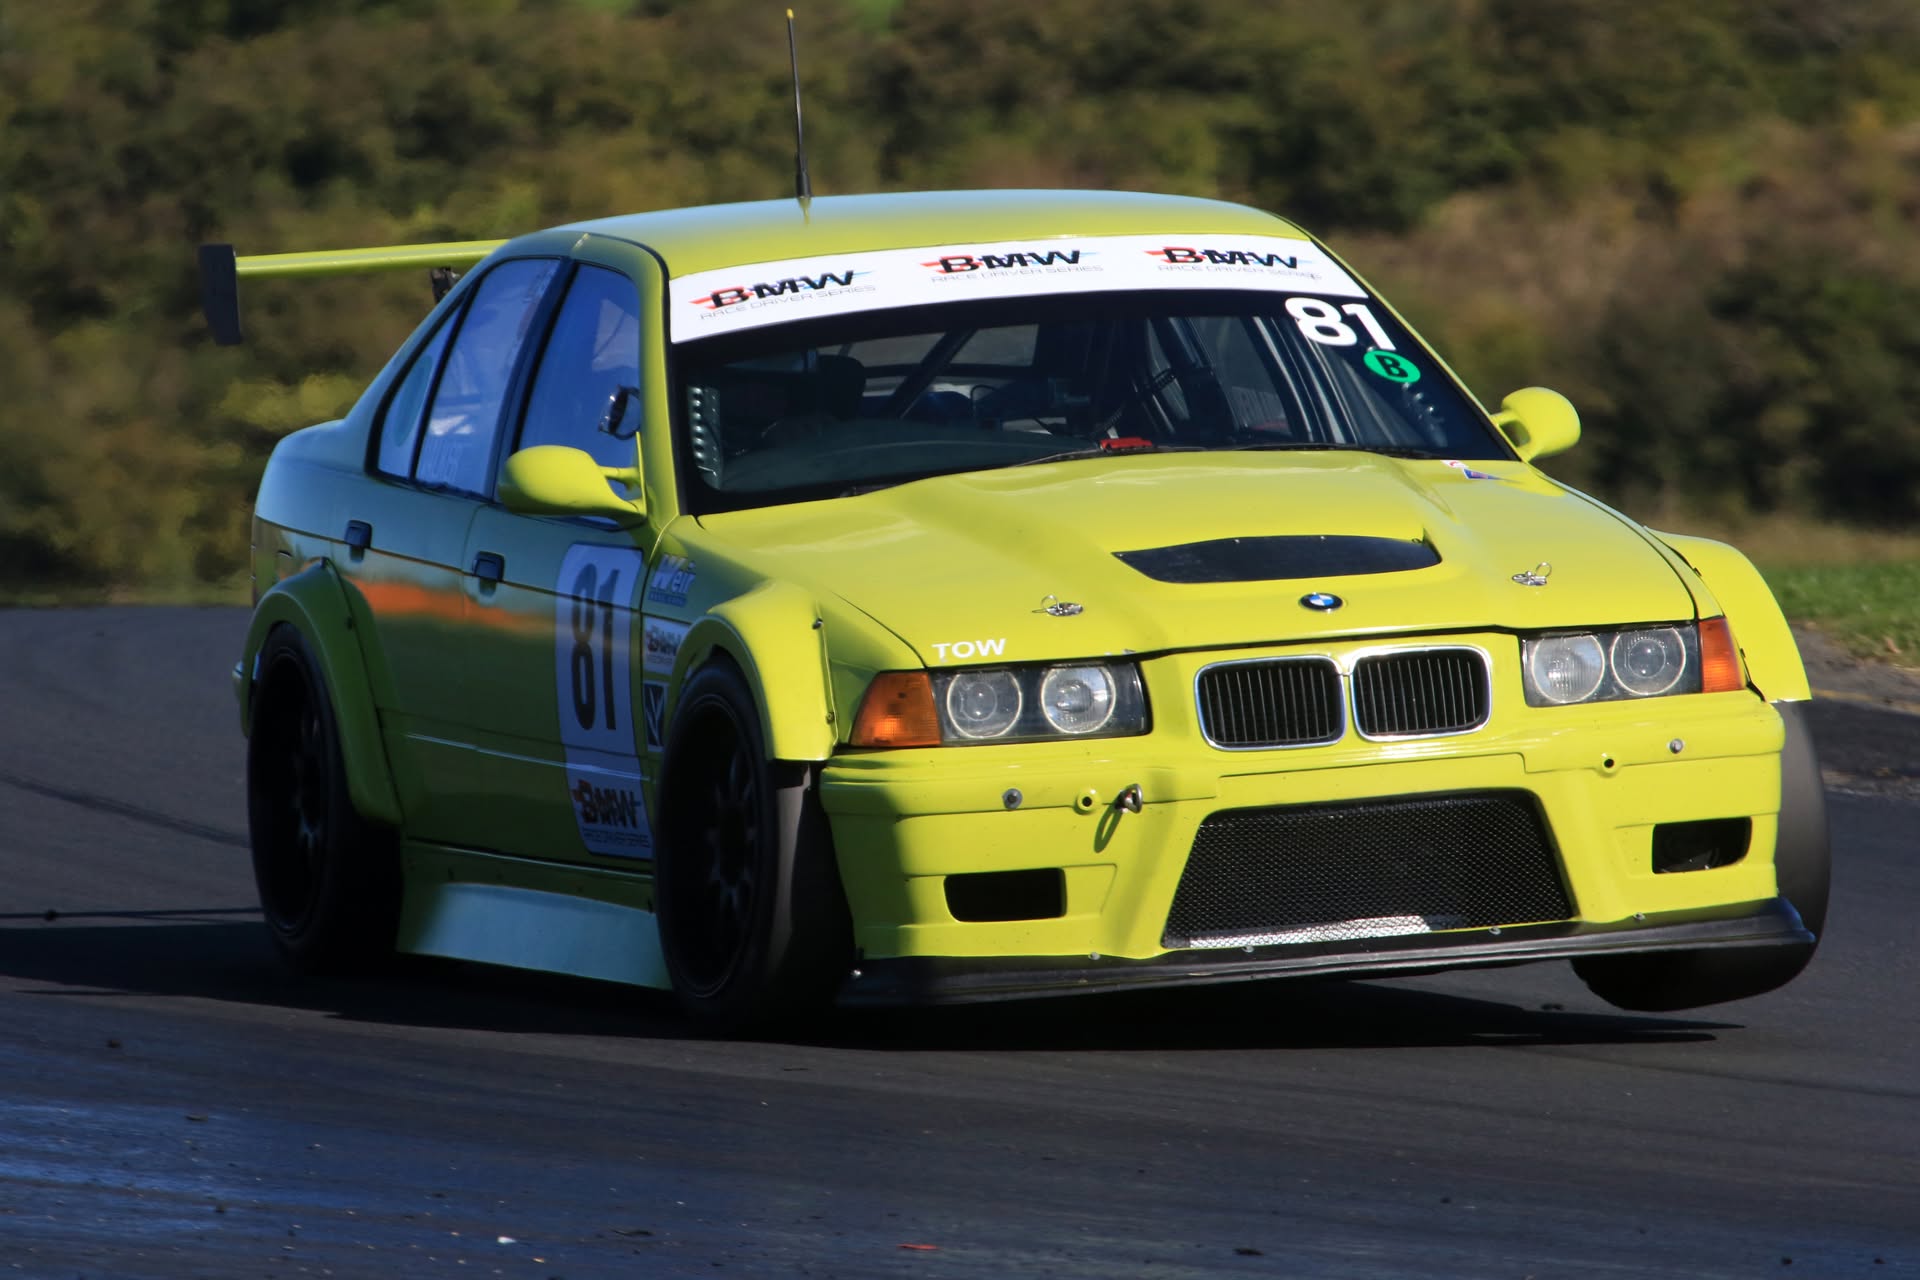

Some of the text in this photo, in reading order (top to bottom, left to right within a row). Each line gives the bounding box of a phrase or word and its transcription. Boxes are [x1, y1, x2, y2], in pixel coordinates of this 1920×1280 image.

[939, 250, 1081, 273] BMW
[1158, 264, 1201, 273] RACE
[1162, 248, 1298, 269] BMW
[710, 270, 854, 307] BMW
[932, 265, 1104, 284] RACE DRIVER SERIES
[700, 284, 877, 320] RACE DRIVER SERIES
[1285, 297, 1396, 350] 81
[1375, 354, 1408, 378] B
[651, 554, 697, 593] Weir
[571, 562, 620, 731] 81
[931, 638, 1006, 660] TOW
[578, 779, 638, 828] BMW
